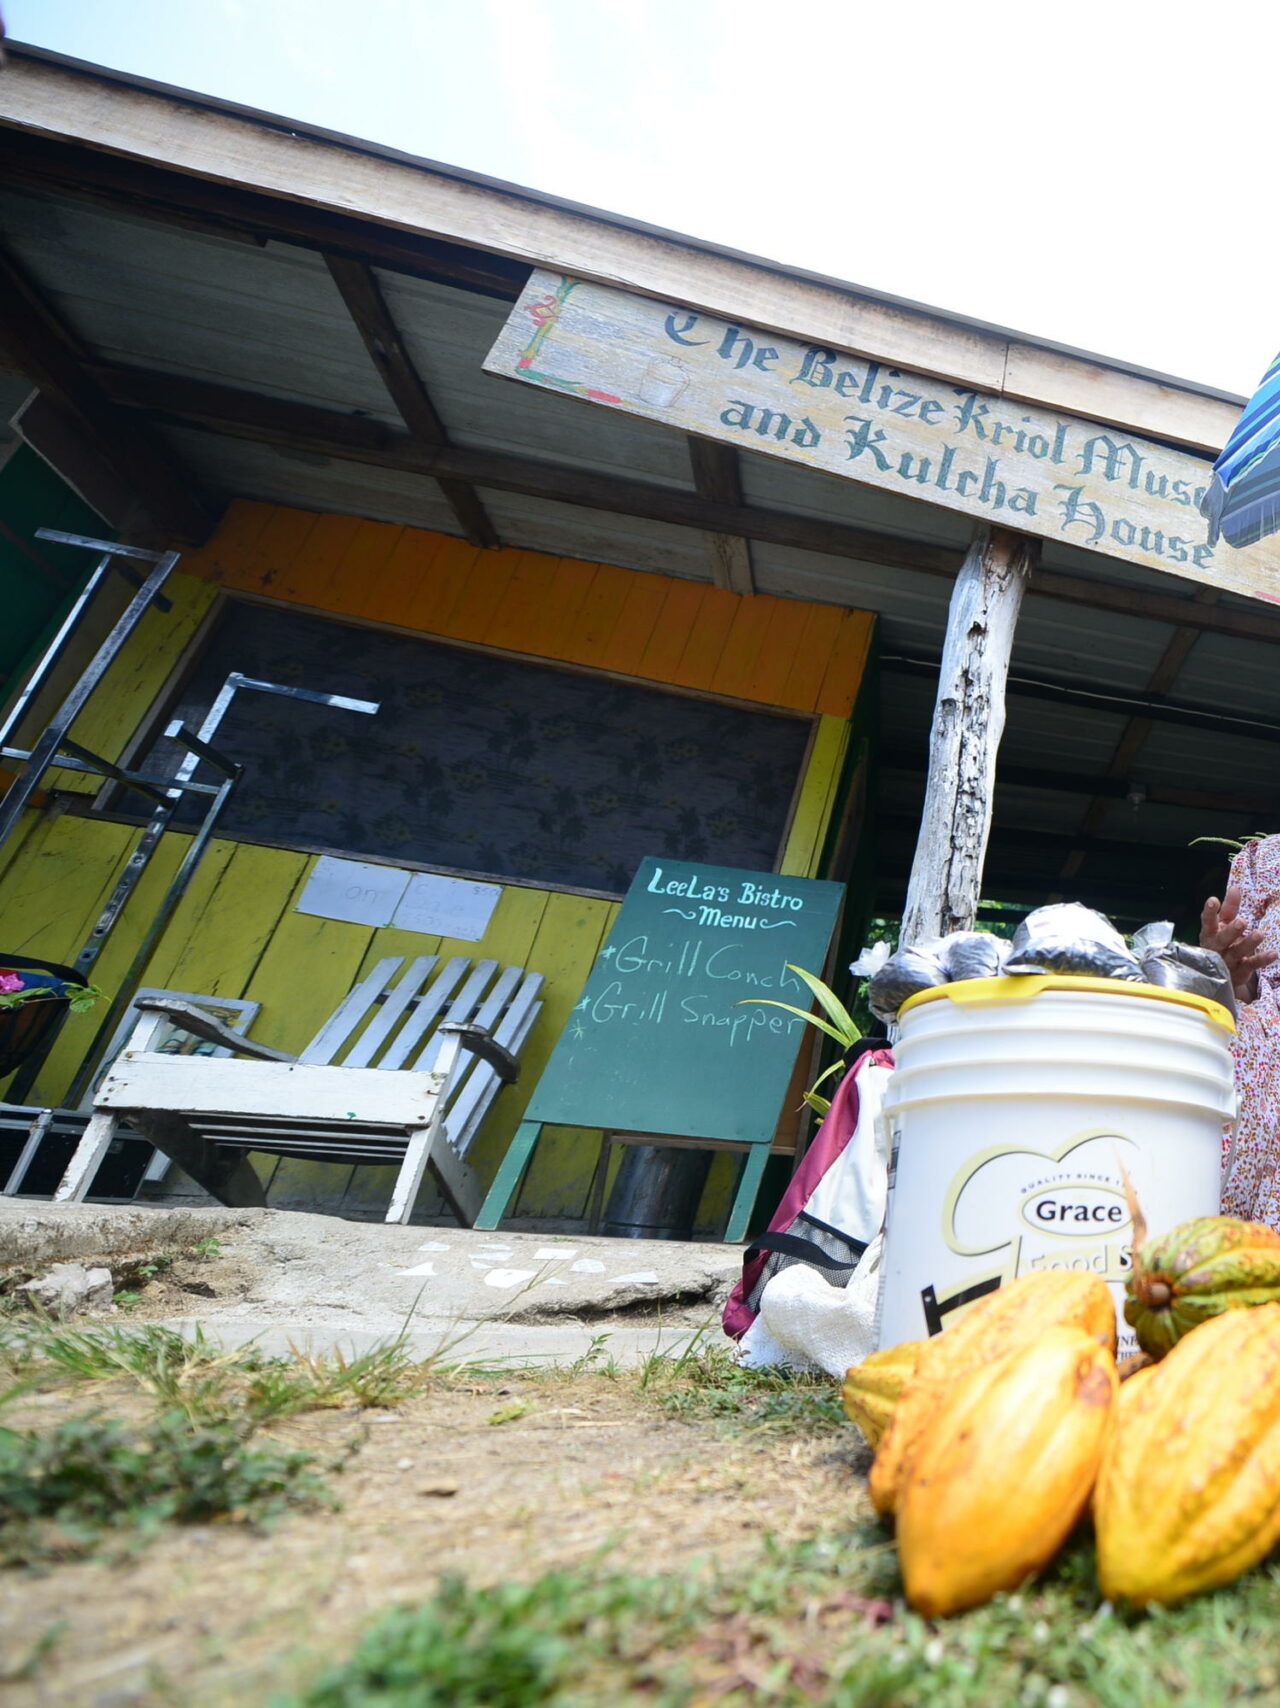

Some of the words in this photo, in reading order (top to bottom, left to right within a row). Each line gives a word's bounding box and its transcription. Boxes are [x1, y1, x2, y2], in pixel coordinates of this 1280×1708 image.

[664, 311, 779, 372] The
[789, 342, 945, 426] Belize
[952, 388, 1072, 465] Kriol
[1074, 434, 1208, 511] Muse
[719, 399, 821, 449] and
[843, 415, 1038, 516] Kulcha
[1053, 483, 1215, 570] House
[699, 906, 757, 930] Menu
[737, 882, 804, 911] Bistro
[615, 935, 702, 977] Grill
[705, 943, 800, 993] Conch
[591, 981, 668, 1024] Grill
[681, 995, 805, 1047] Snapper
[1035, 1199, 1123, 1223] Grace
